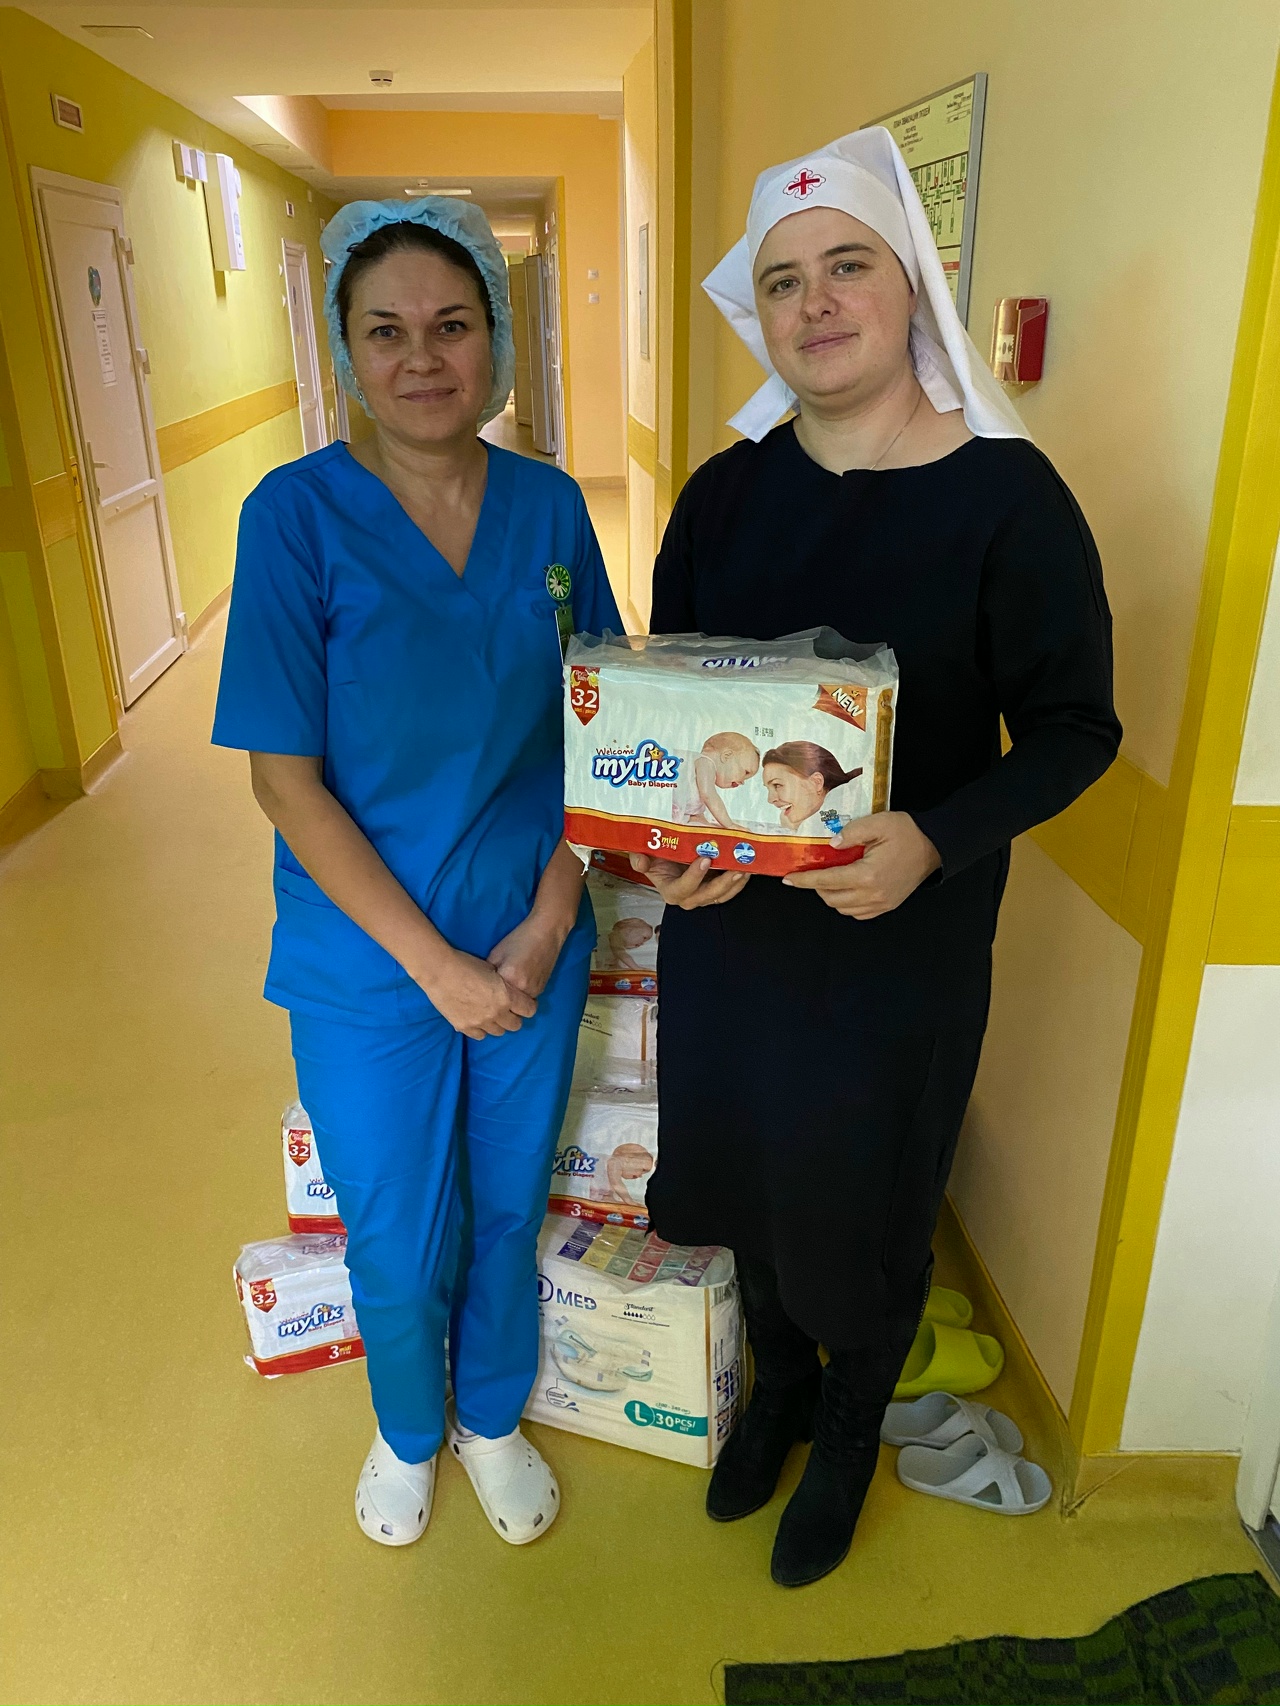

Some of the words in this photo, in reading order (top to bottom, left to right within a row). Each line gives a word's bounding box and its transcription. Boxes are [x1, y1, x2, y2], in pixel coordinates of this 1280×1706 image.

[572, 688, 598, 709] 32
[831, 687, 864, 718] NEW
[596, 747, 635, 756] Welcome
[593, 741, 677, 786] myfix
[627, 780, 647, 788] Baby
[648, 781, 678, 789] Diapers
[647, 828, 662, 850] 3
[661, 836, 680, 845] midi
[289, 1145, 309, 1157] 32
[552, 1146, 595, 1172] yfix
[570, 1203, 581, 1217] 3
[254, 1292, 275, 1305] 32
[556, 1287, 597, 1311] MED
[278, 1303, 343, 1336] myfix
[329, 1345, 340, 1359] 3
[634, 1403, 648, 1423] L
